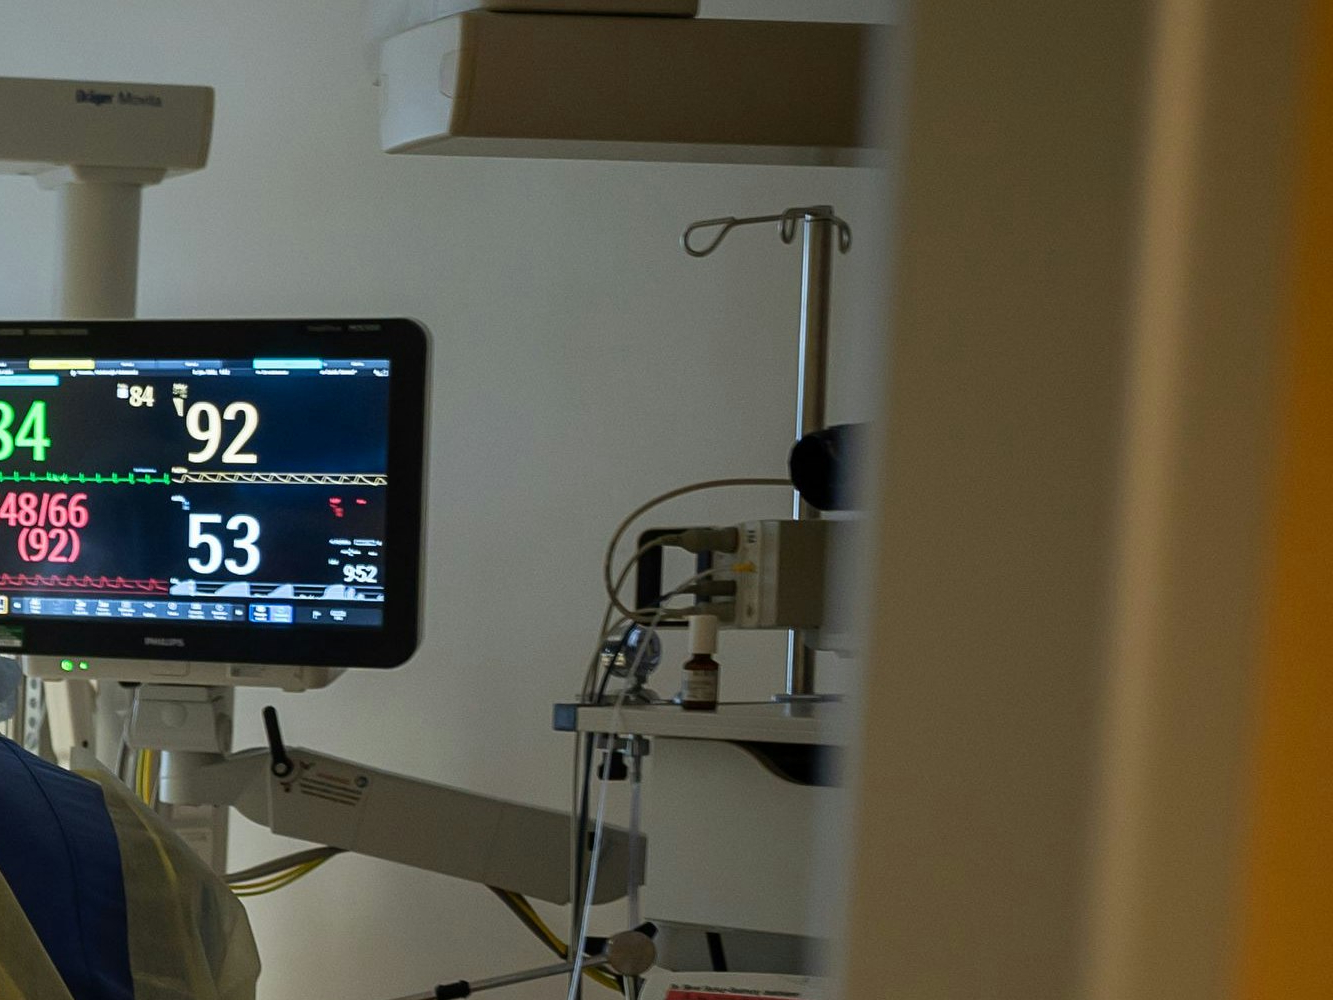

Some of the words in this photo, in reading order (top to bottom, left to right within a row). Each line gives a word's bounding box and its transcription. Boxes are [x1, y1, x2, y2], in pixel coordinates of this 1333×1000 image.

[129, 385, 155, 407] 84
[185, 400, 259, 464] 92
[17, 528, 81, 563] (92)
[187, 513, 261, 576] 53
